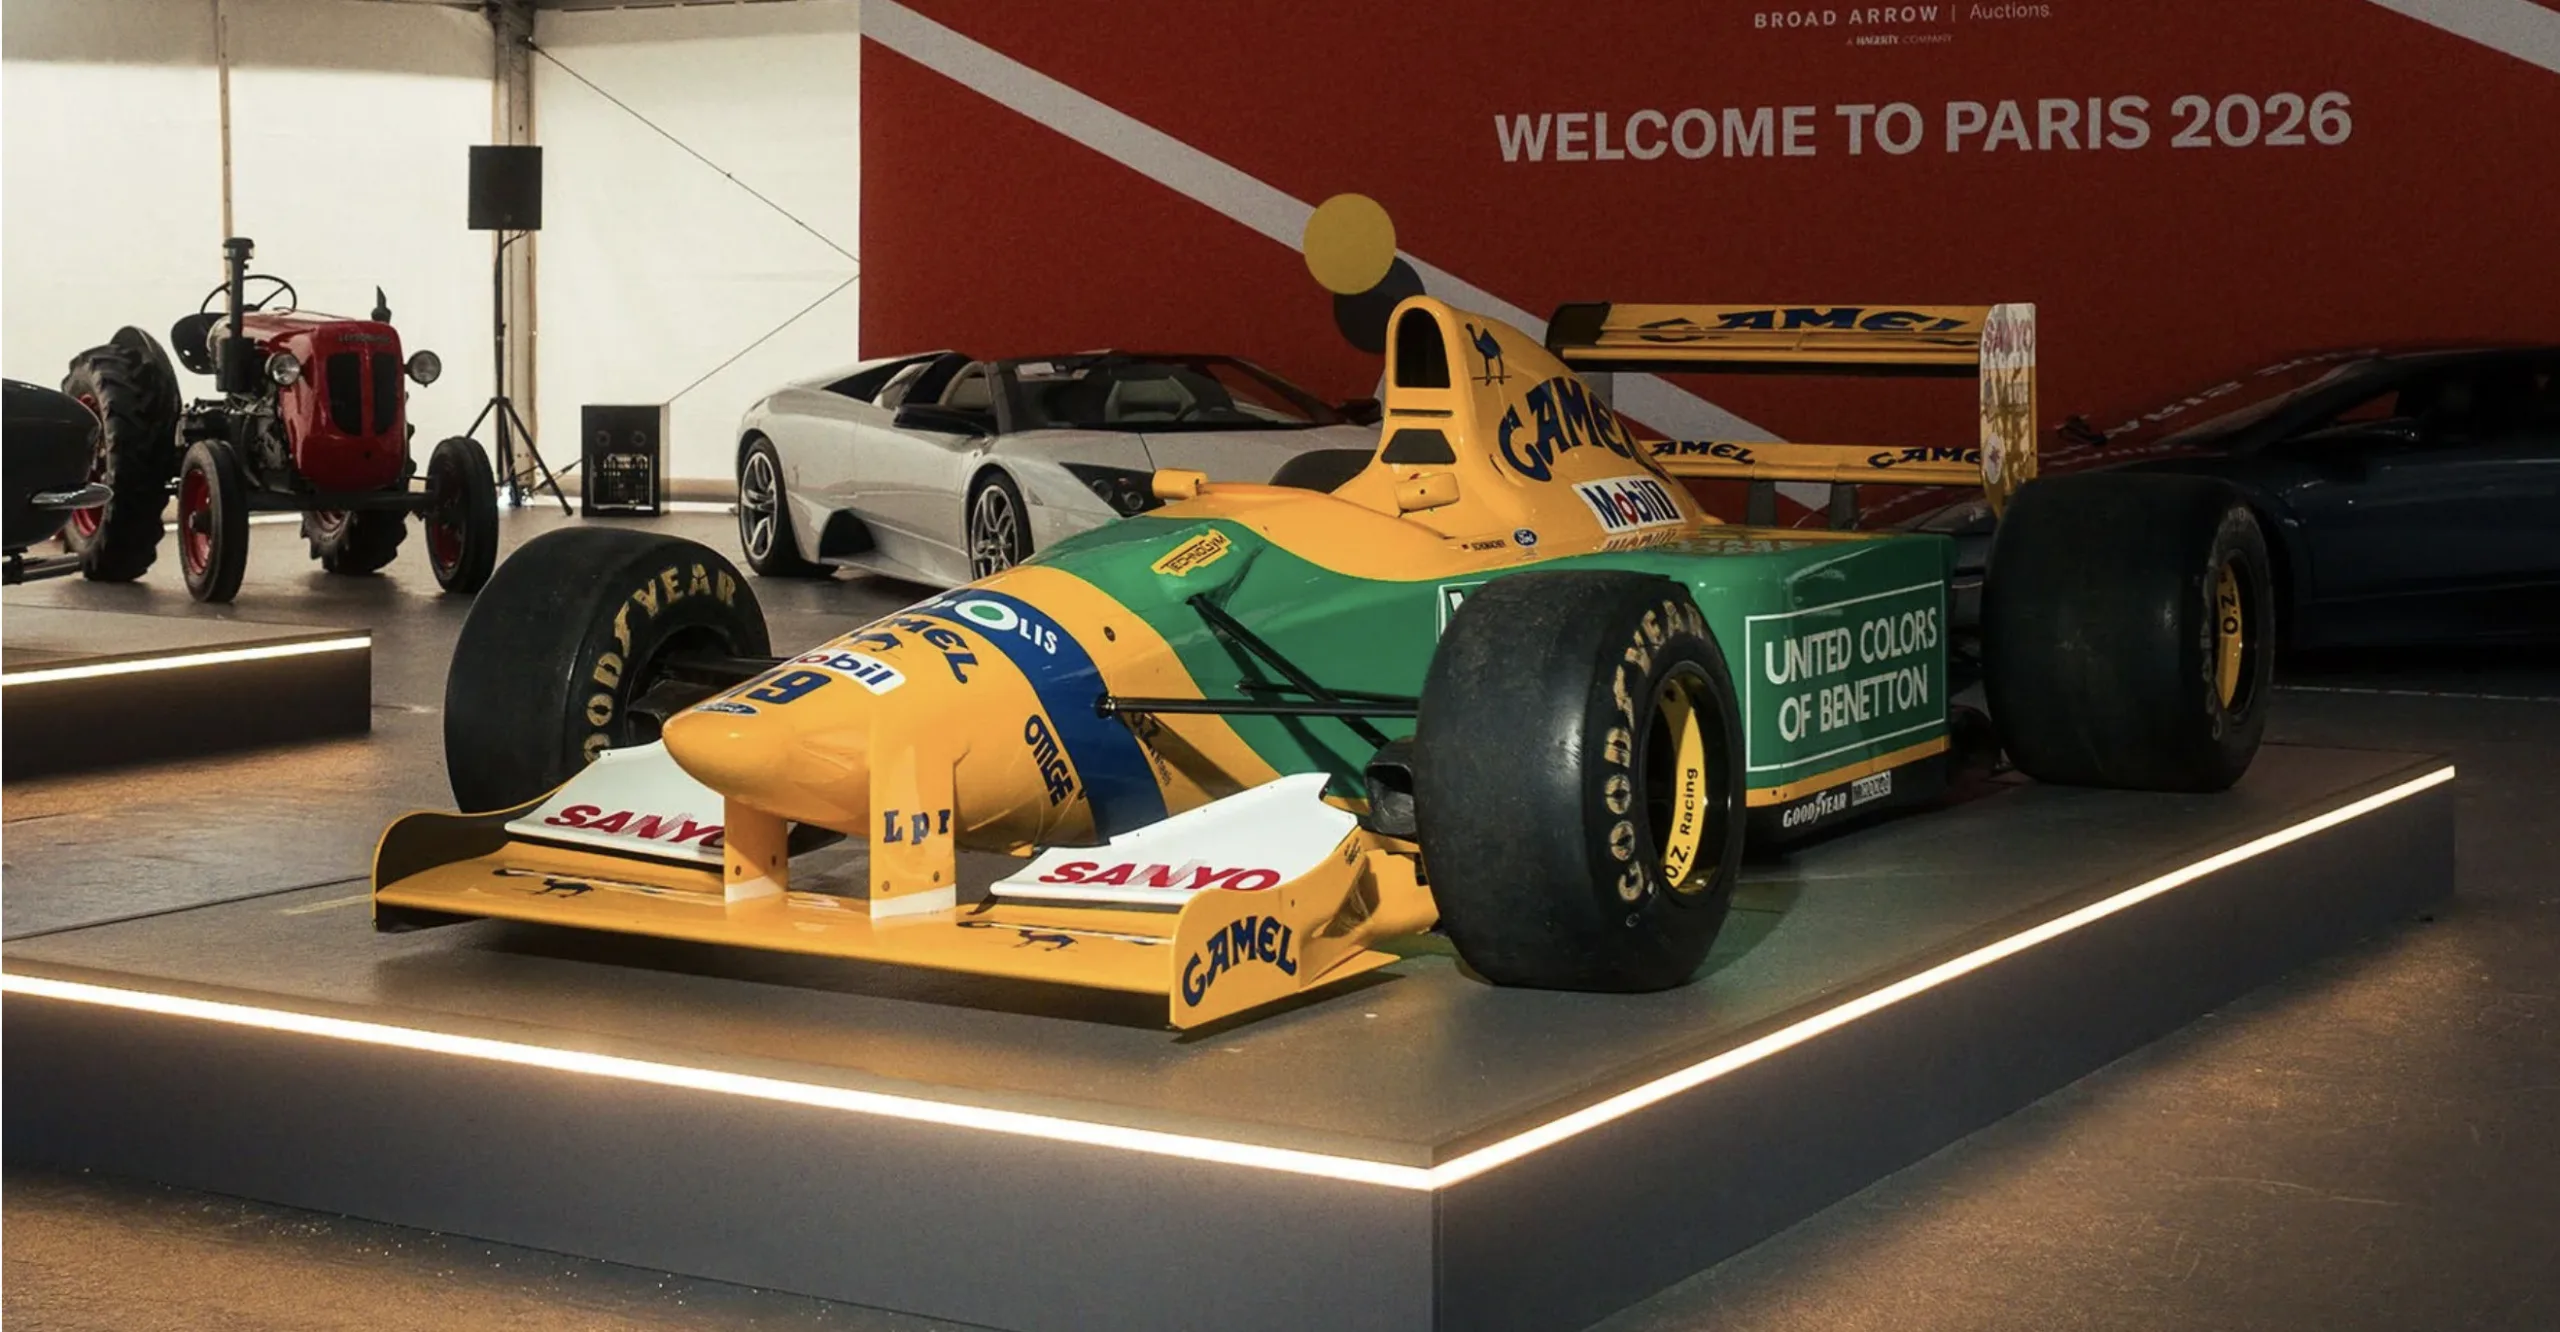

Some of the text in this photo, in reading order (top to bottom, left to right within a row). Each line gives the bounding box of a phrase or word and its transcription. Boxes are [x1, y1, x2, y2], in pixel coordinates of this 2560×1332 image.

[1755, 10, 1836, 28] BROAD
[1849, 6, 1938, 25] ARROW
[1495, 91, 2353, 163] WELCOME TO PARIS 2026
[1650, 439, 1755, 464] AMEL
[1867, 447, 1980, 468] CAME
[1582, 480, 1665, 528] Mobil
[583, 563, 737, 763] OODYEAR
[799, 653, 896, 687] obil
[1765, 607, 1937, 685] UNITED COLORS
[1778, 664, 1927, 742] OF BENETTON
[1663, 768, 1699, 880] O.Z. Racing
[1782, 790, 1848, 828] GOODYEAR
[1039, 860, 1281, 892] SANYO
[1182, 915, 1297, 1008] CAMEL
